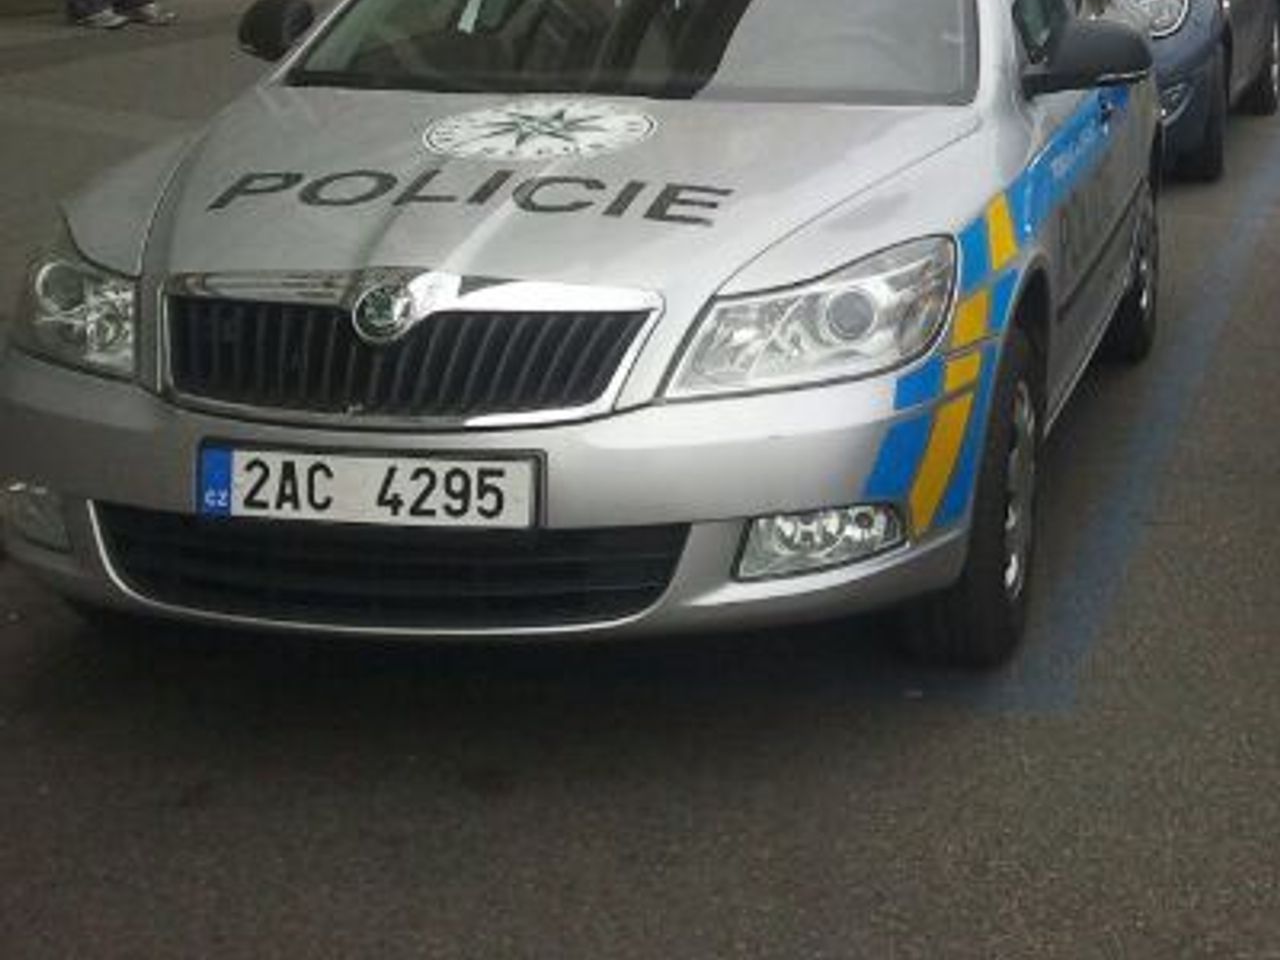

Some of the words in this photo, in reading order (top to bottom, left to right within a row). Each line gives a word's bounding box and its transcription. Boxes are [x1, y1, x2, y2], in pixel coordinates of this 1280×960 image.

[206, 168, 734, 227] POLICIE
[243, 458, 334, 512] 2AC
[376, 465, 507, 519] 4295
